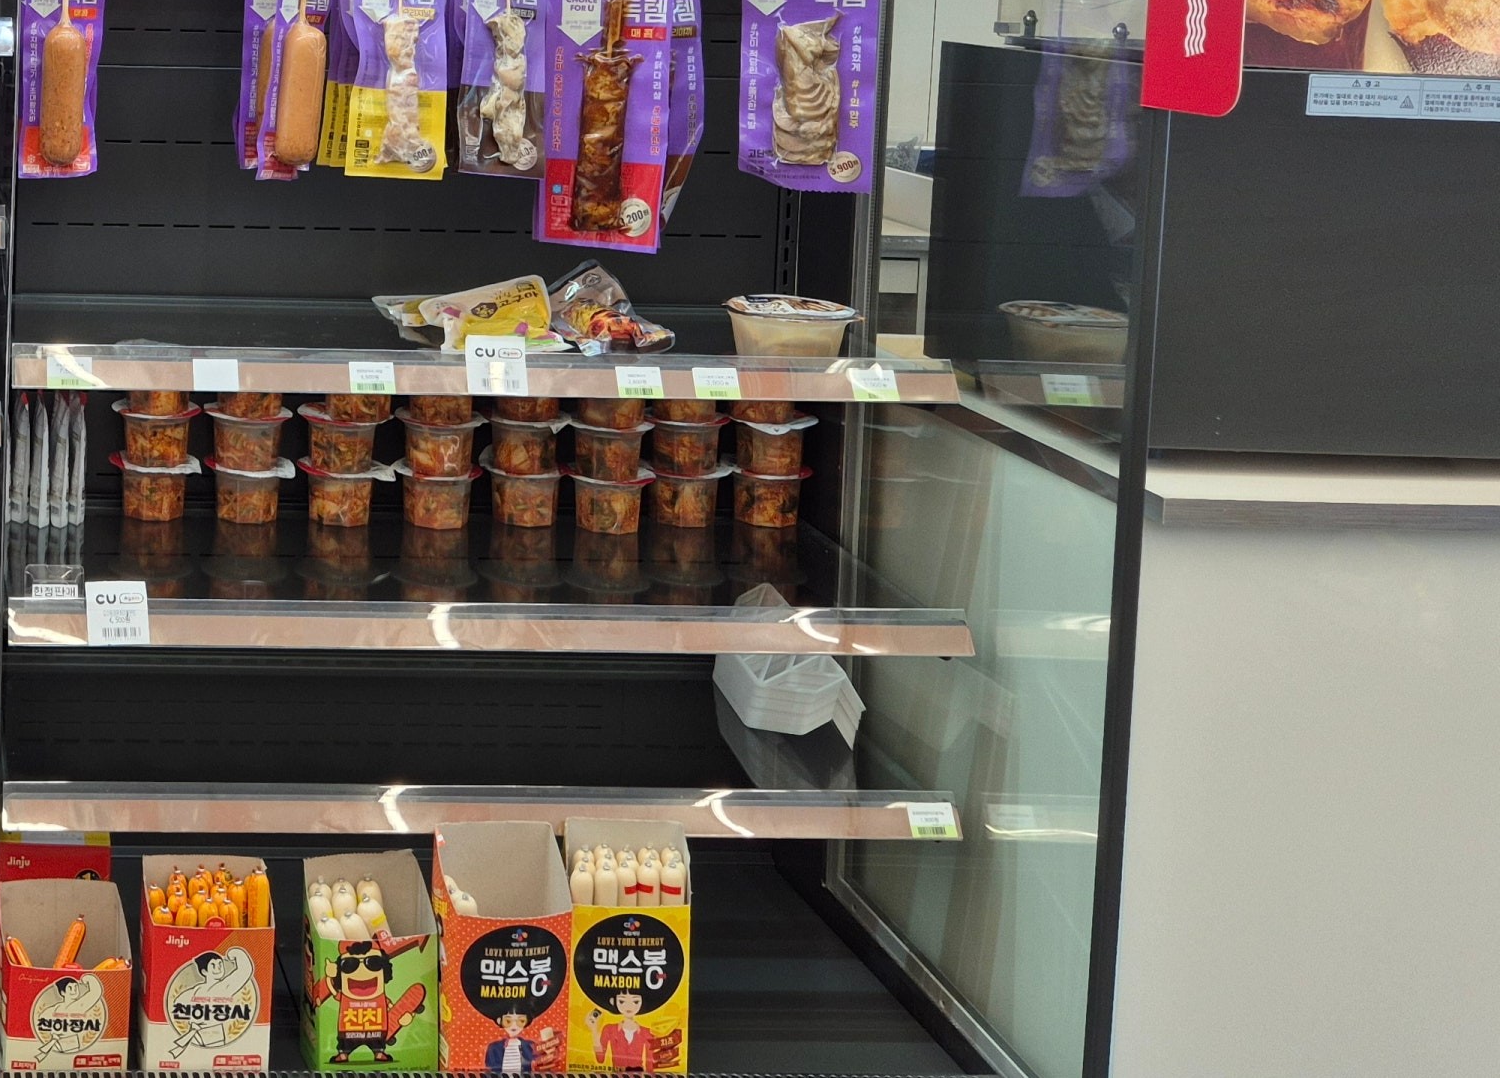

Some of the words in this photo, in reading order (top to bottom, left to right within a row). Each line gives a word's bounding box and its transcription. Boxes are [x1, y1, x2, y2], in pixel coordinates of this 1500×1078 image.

[570, 4, 586, 12] FOR
[588, 4, 595, 12] U
[475, 348, 496, 358] CU
[33, 585, 76, 597] 한정판매
[95, 593, 117, 604] CU
[7, 855, 31, 869] Jinju
[165, 934, 190, 948] Jinju
[597, 937, 615, 947] LOVE
[617, 936, 636, 947] YOUR
[638, 936, 665, 947] ENERGY
[485, 947, 503, 957] LOVE
[504, 947, 524, 957] YOUR
[525, 945, 550, 956] ENERGY
[593, 948, 667, 990] 맥스봉
[480, 956, 552, 998] 맥스봉
[594, 975, 641, 990] MAXBON
[480, 985, 526, 999] MAXBON
[172, 1002, 251, 1022] 천하장사
[343, 1008, 383, 1030] 친친
[37, 1016, 101, 1033] 천하장사
